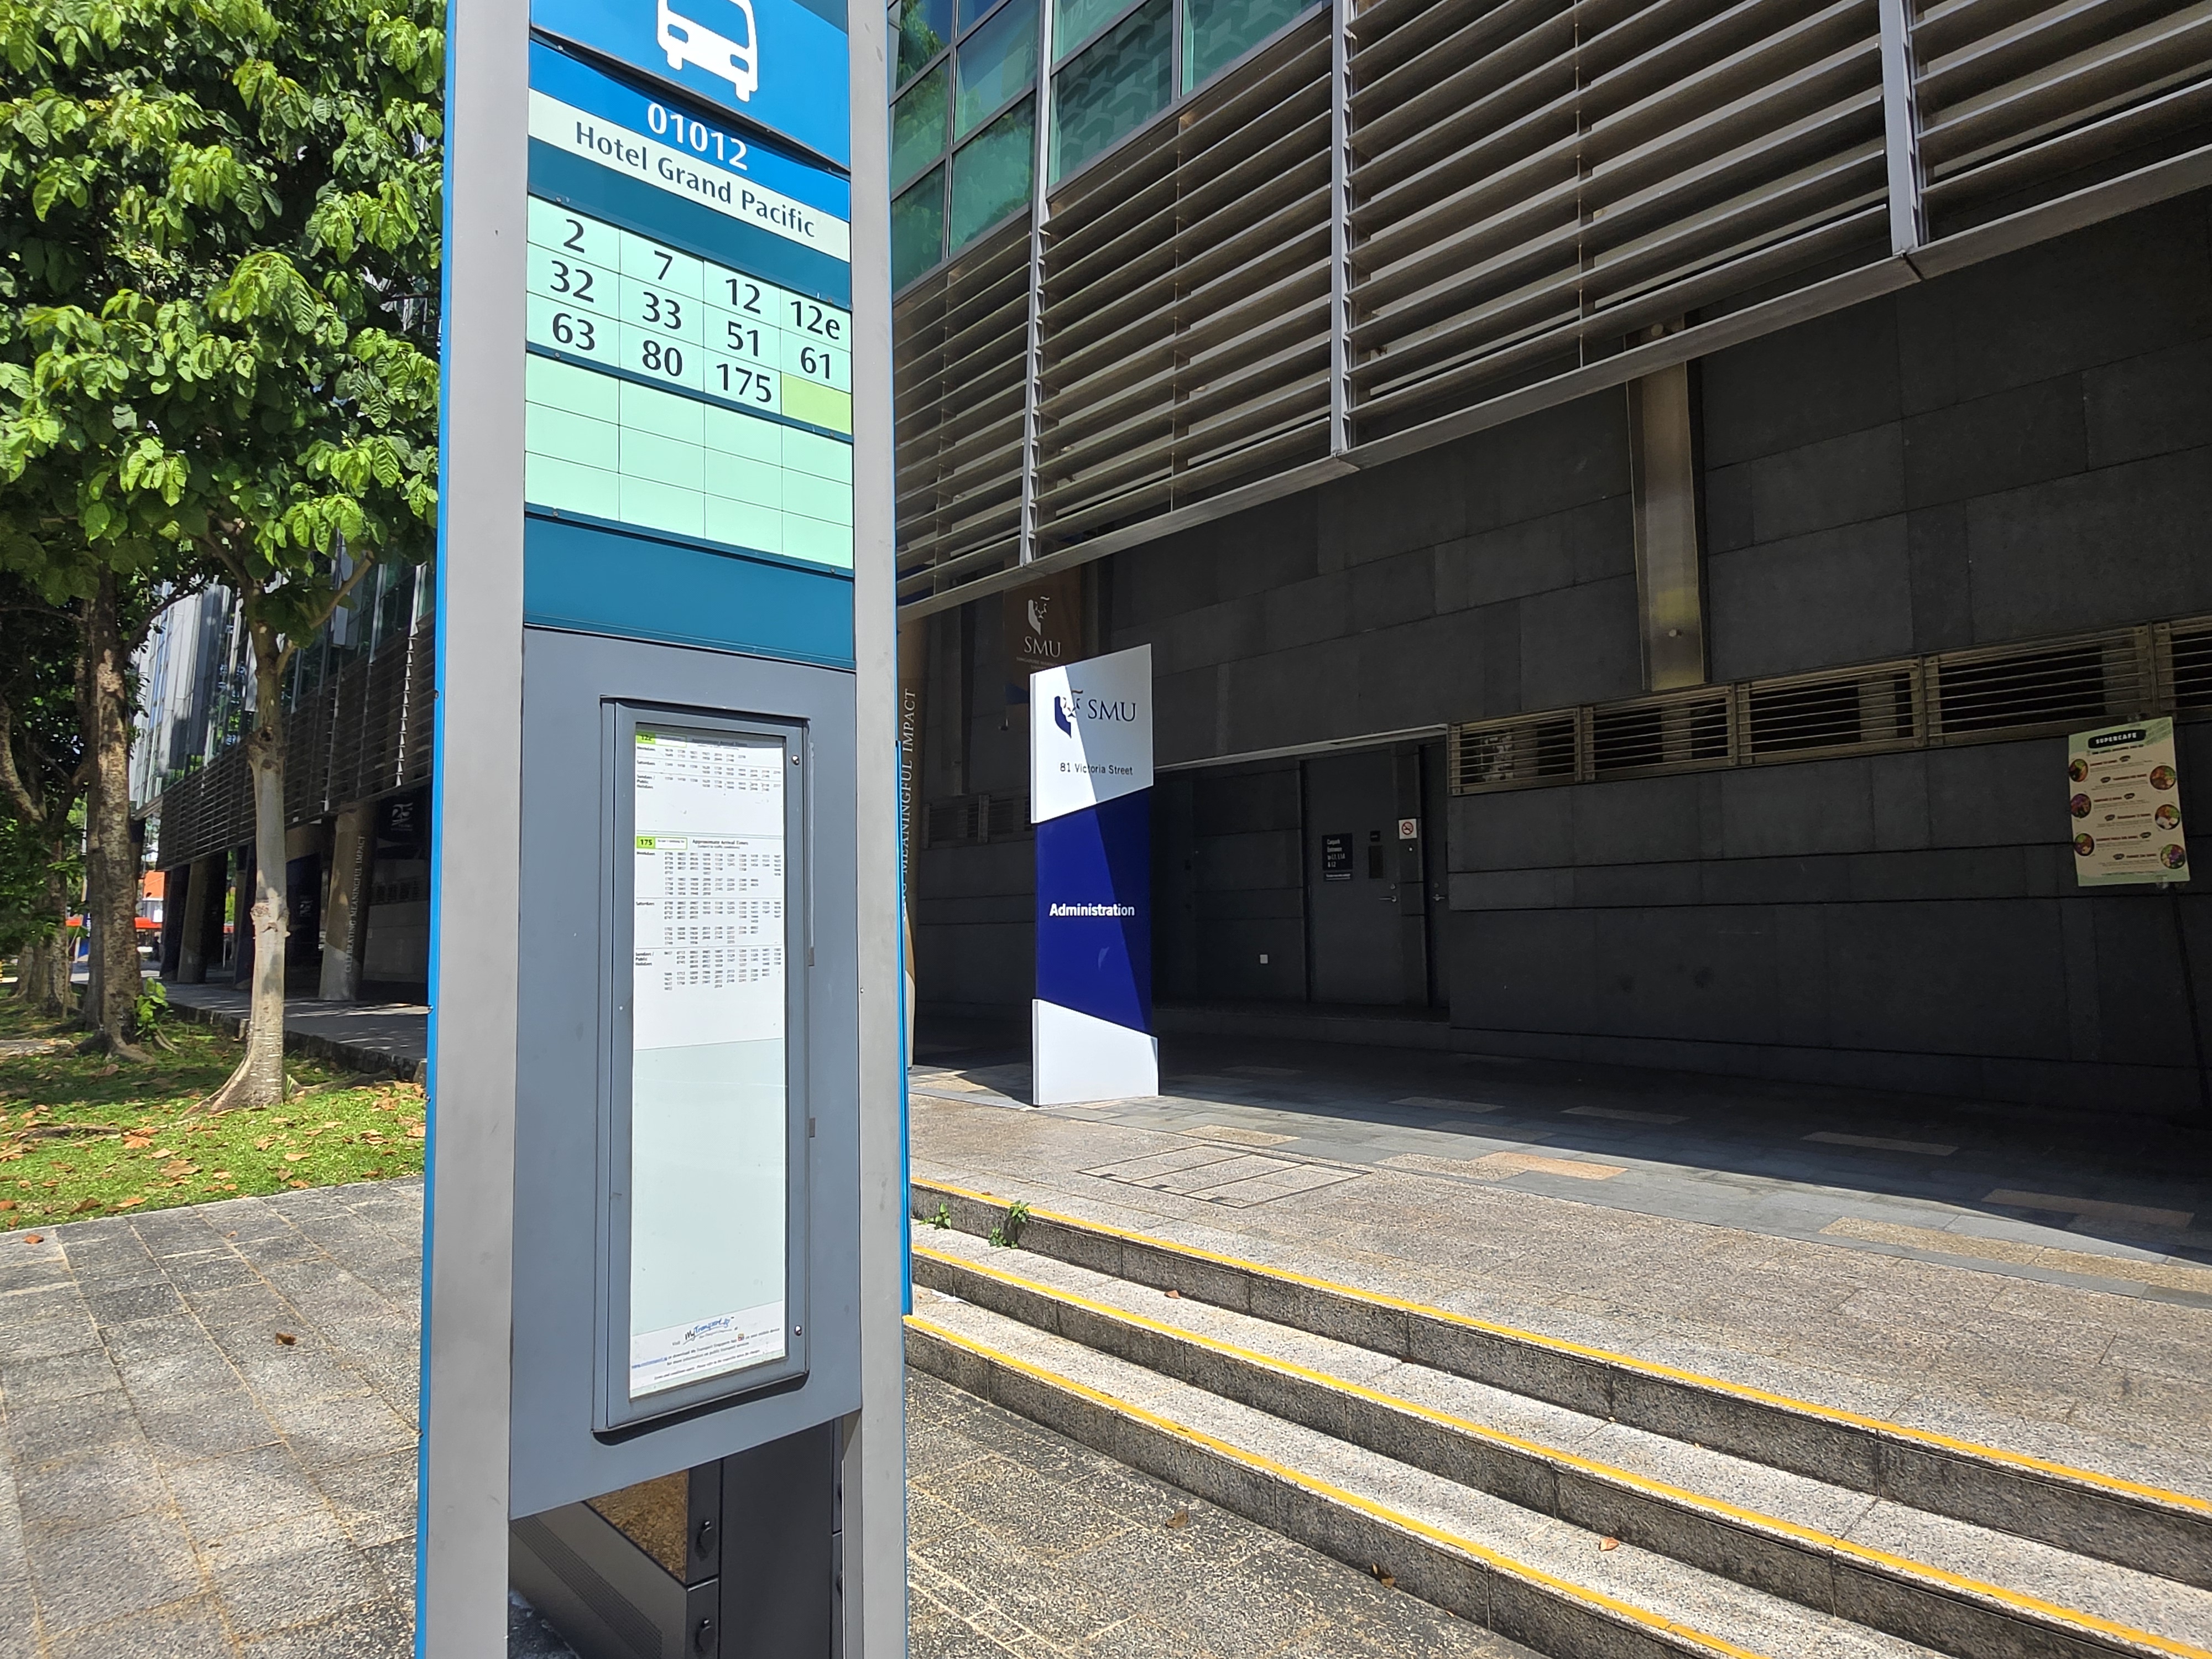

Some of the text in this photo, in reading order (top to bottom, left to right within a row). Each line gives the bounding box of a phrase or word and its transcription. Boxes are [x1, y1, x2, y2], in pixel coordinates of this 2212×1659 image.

[648, 103, 748, 171] 01012
[576, 121, 815, 238] Hotel Grand Pacific
[563, 218, 841, 341] 2 7 12 12e
[550, 260, 831, 380] 32 33 51 61
[552, 312, 772, 403] 63 80 175
[1024, 635, 1061, 658] SMU
[902, 688, 916, 753] IMPACT
[1087, 699, 1136, 722] SMU
[2095, 732, 2137, 744] SUPERCAFE
[1060, 763, 1133, 775] 81 Victoria Street
[349, 867, 362, 916] MEANINGFUL
[356, 836, 366, 864] IMPACT
[1049, 902, 1135, 916] Administration
